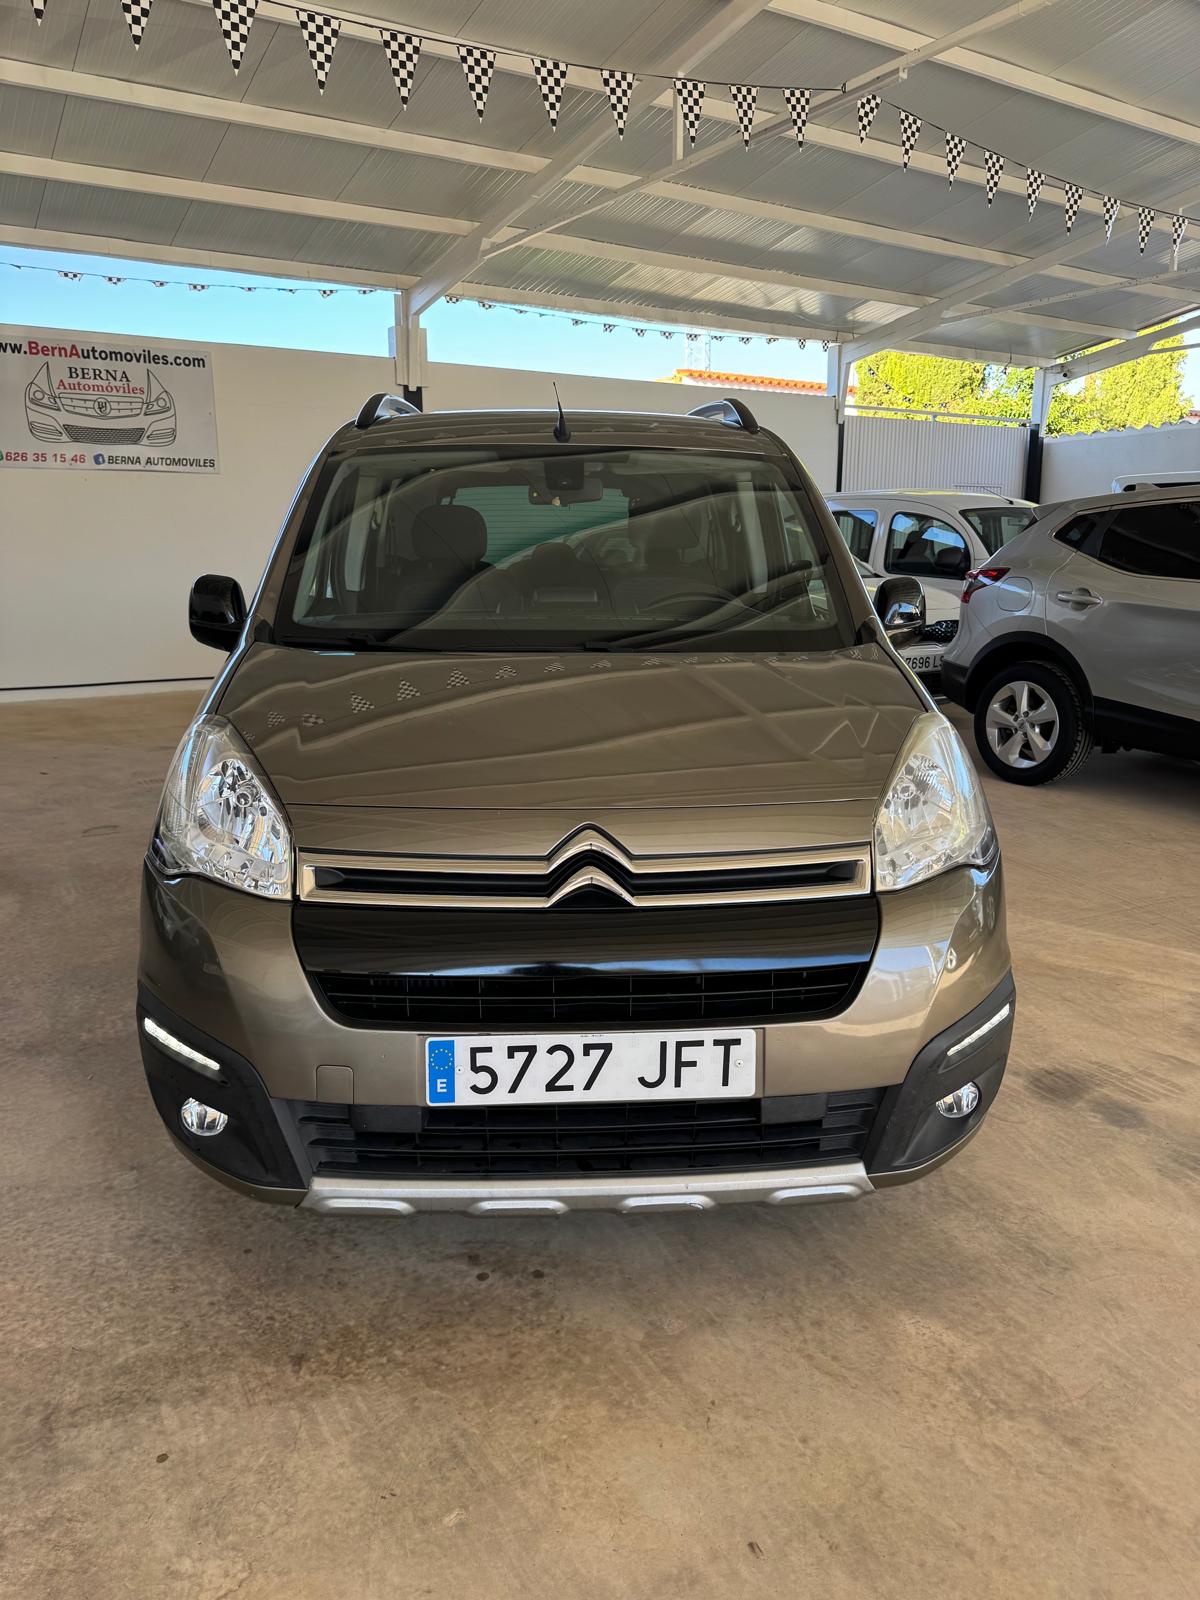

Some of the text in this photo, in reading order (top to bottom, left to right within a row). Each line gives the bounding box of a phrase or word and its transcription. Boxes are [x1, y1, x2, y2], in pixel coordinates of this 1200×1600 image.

[67, 366, 131, 382] BERNA
[57, 379, 145, 395] Automóviles
[5, 451, 86, 463] 626 35 15 46
[107, 455, 215, 468] BERNA AUTOMOVILES
[469, 1038, 742, 1095] 5727 JFT
[436, 1079, 447, 1093] E
